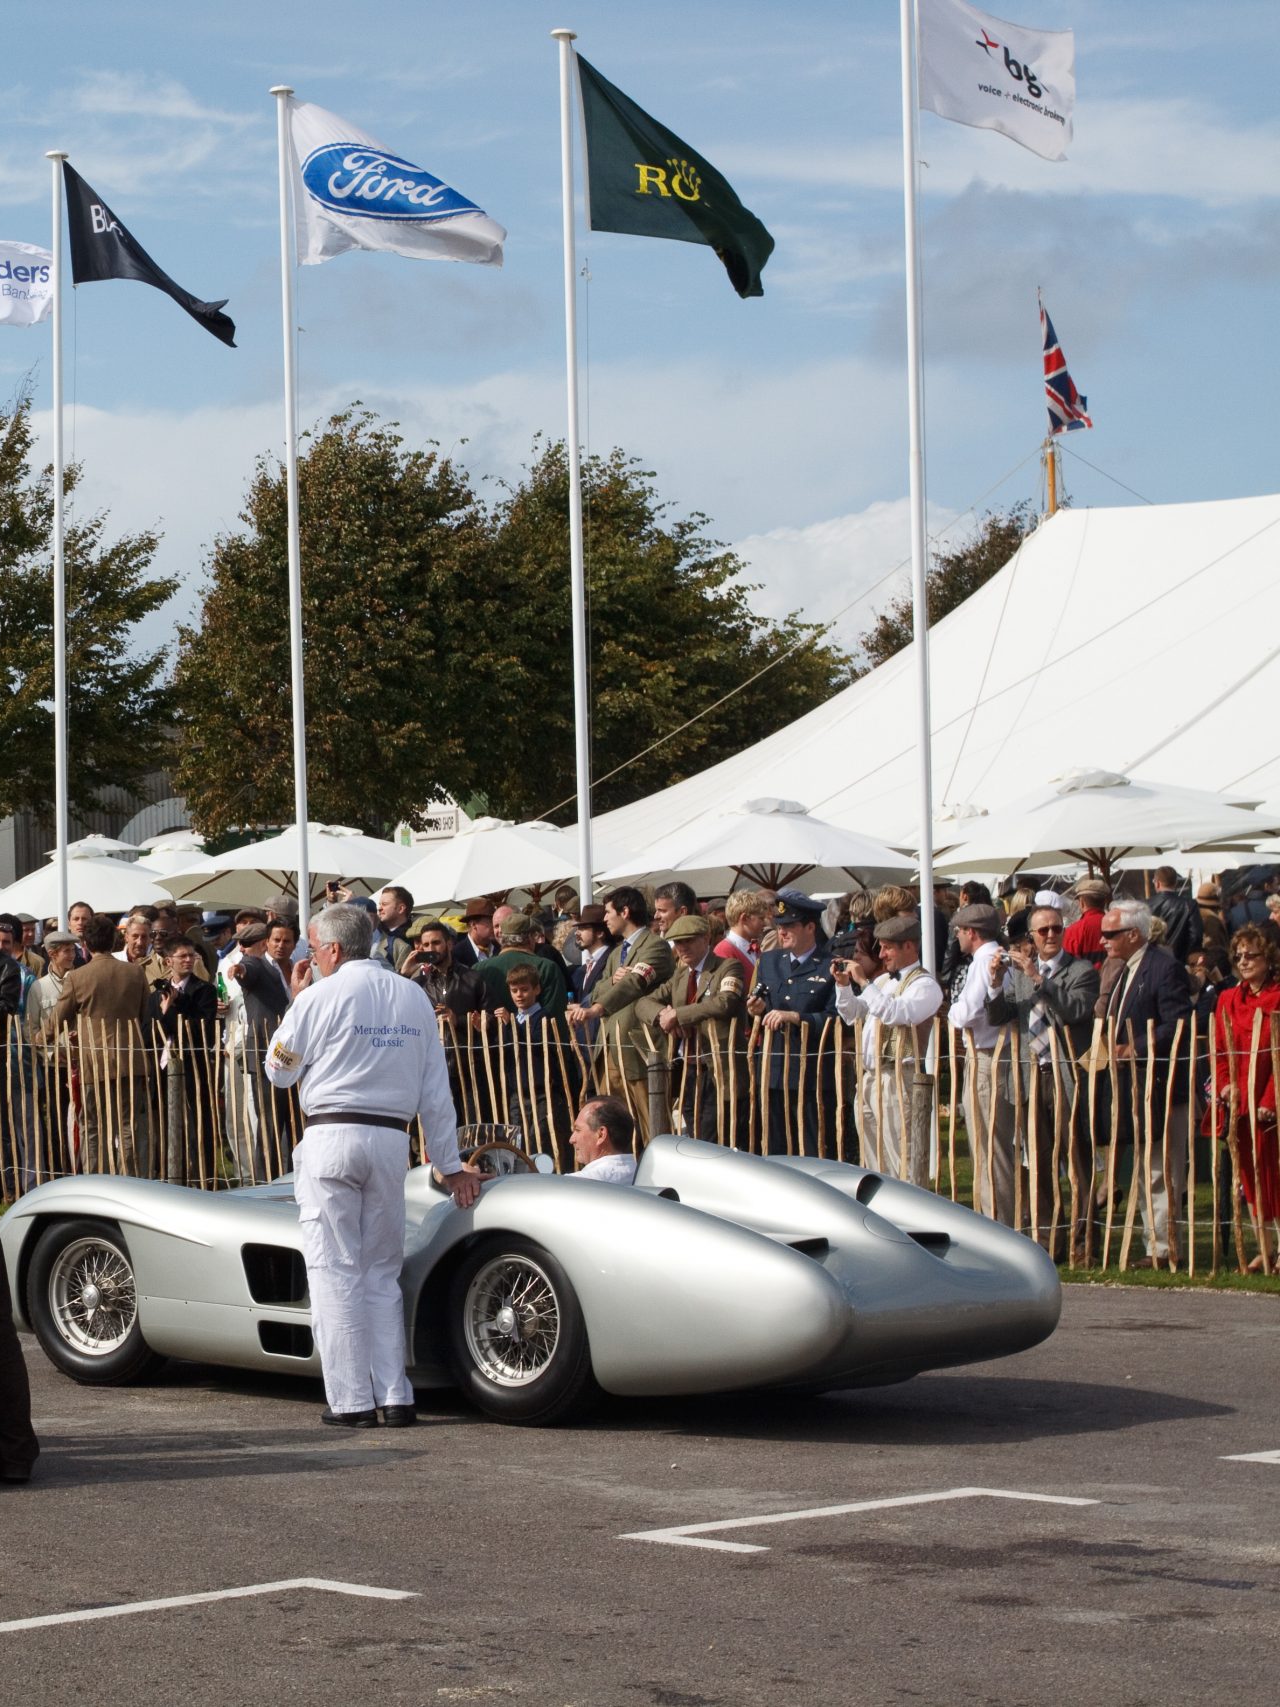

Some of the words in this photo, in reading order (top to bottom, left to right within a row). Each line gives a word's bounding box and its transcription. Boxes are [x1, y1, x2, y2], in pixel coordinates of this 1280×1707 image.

[978, 83, 1002, 97] voice
[1012, 93, 1043, 114] electronic
[328, 152, 449, 206] Ford
[354, 1025, 421, 1037] Mercedes-Benz
[372, 1037, 405, 1048] Classic
